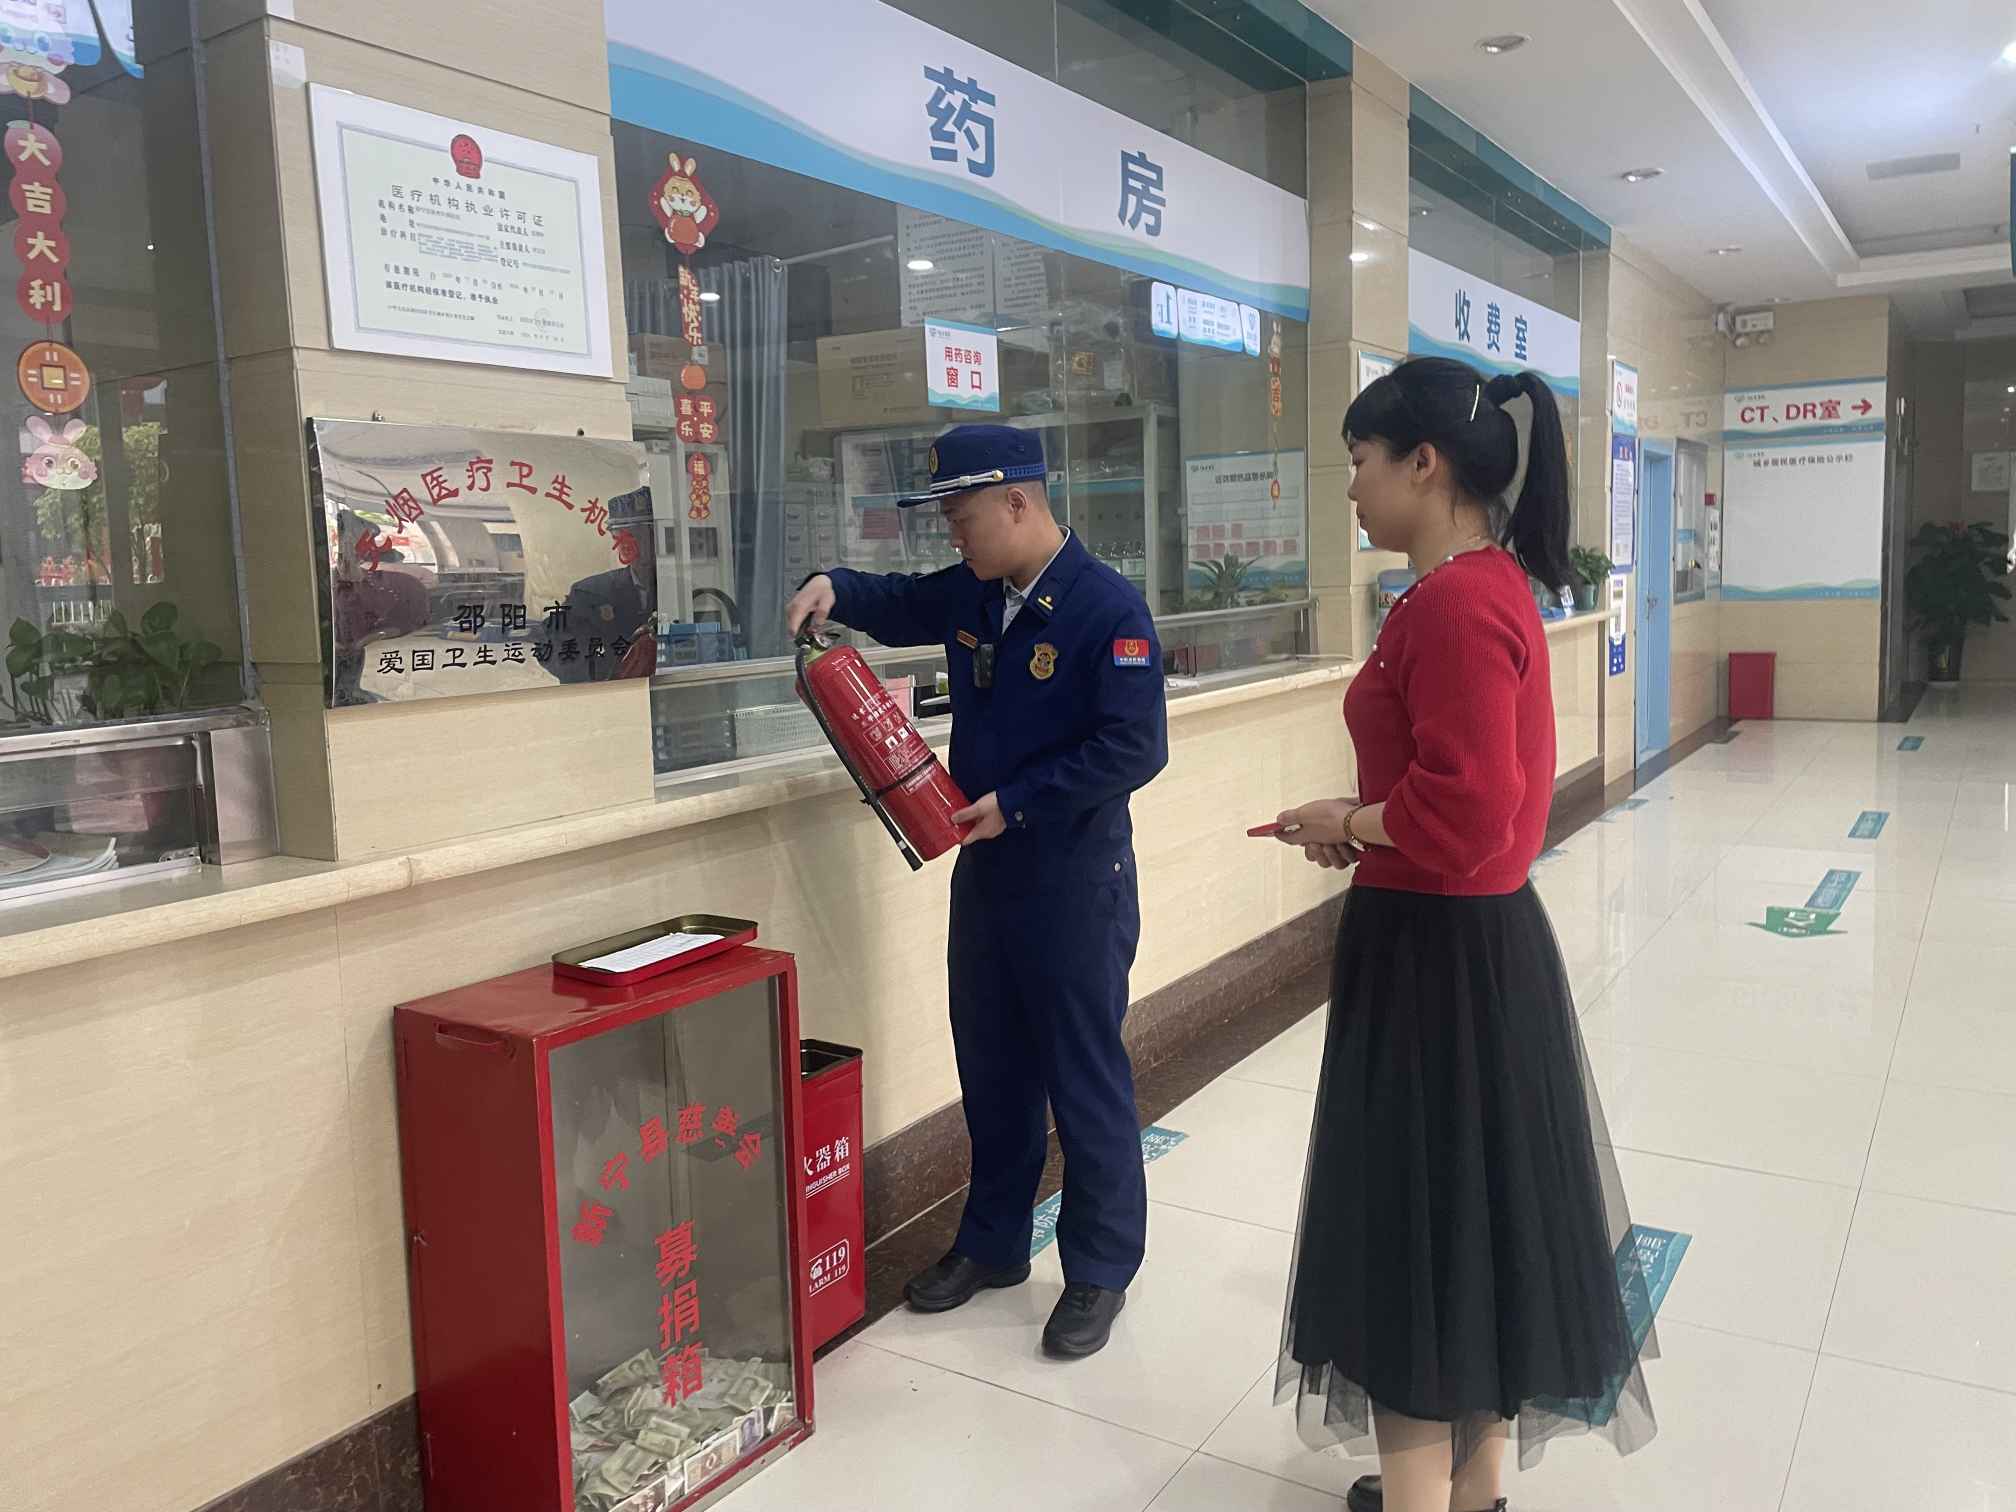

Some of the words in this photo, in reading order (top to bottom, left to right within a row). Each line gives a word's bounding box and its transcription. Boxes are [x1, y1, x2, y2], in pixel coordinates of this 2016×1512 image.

[924, 65, 1167, 237] 药房
[17, 133, 62, 311] 大吉大利
[391, 184, 545, 228] 医疗机构执业许可证
[1455, 288, 1528, 361] 收费室
[944, 345, 983, 366] 用药咨询
[945, 366, 982, 391] 窗口
[355, 456, 640, 570] 无烟医疗卫生机构
[453, 600, 572, 635] 邵阳市
[376, 635, 633, 675] 爱国卫生运动委员会
[825, 1246, 846, 1271] 119
